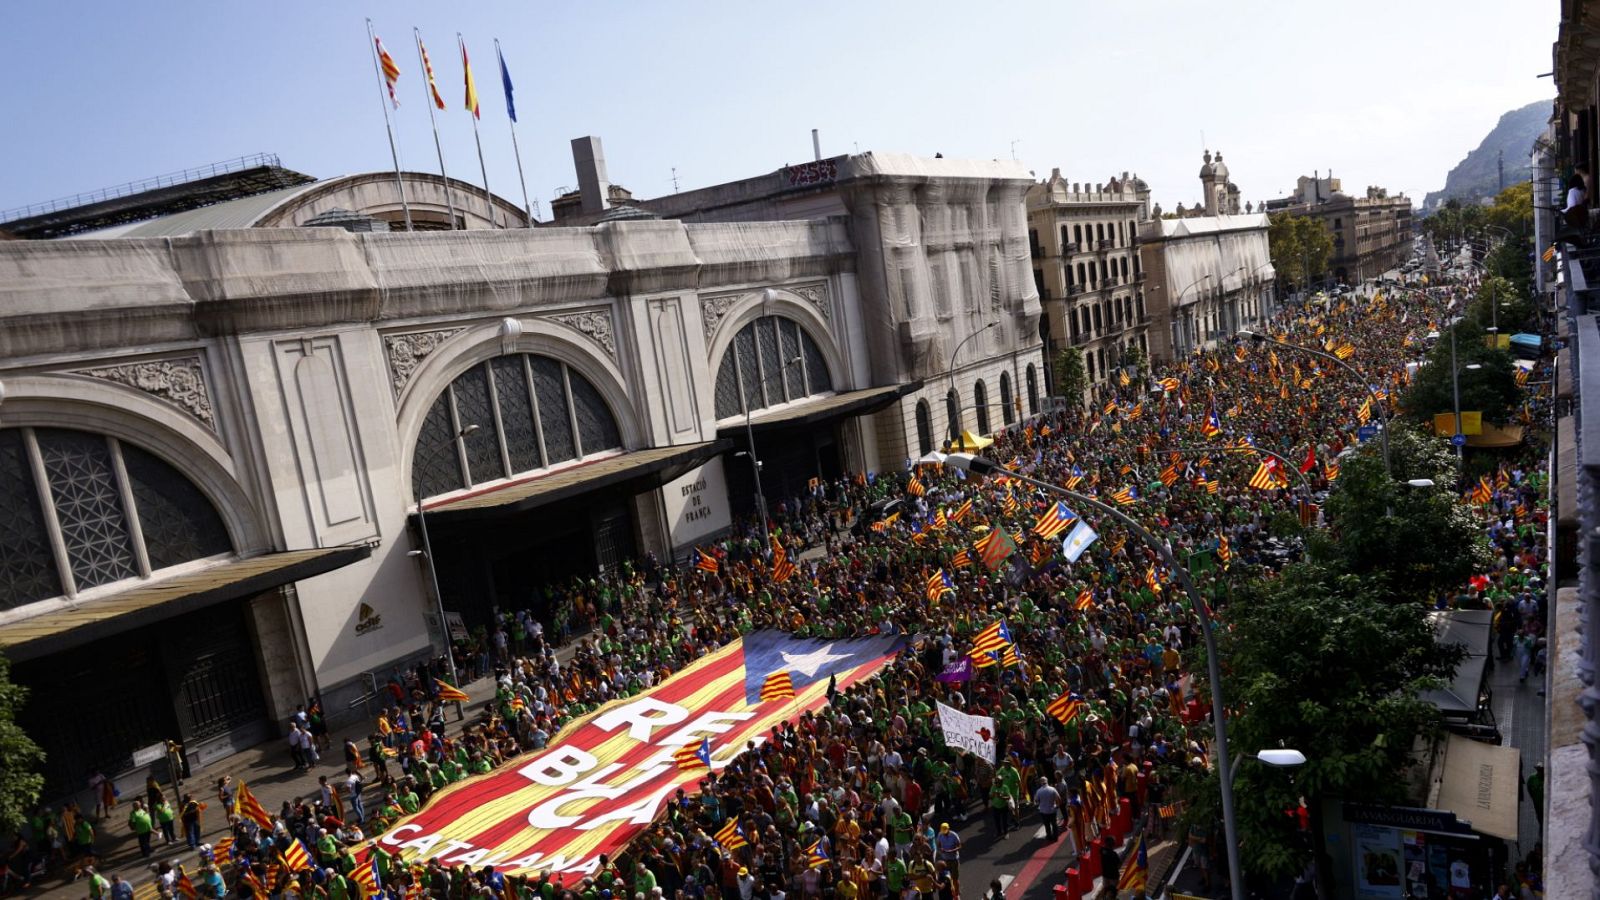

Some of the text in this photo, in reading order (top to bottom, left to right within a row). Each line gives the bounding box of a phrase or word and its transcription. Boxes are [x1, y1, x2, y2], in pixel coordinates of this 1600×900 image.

[681, 477, 707, 497] ESTACIÓ
[692, 495, 701, 506] DE
[686, 505, 712, 523] FRANÇA
[355, 614, 382, 632] adif
[381, 823, 602, 875] CATALANA
